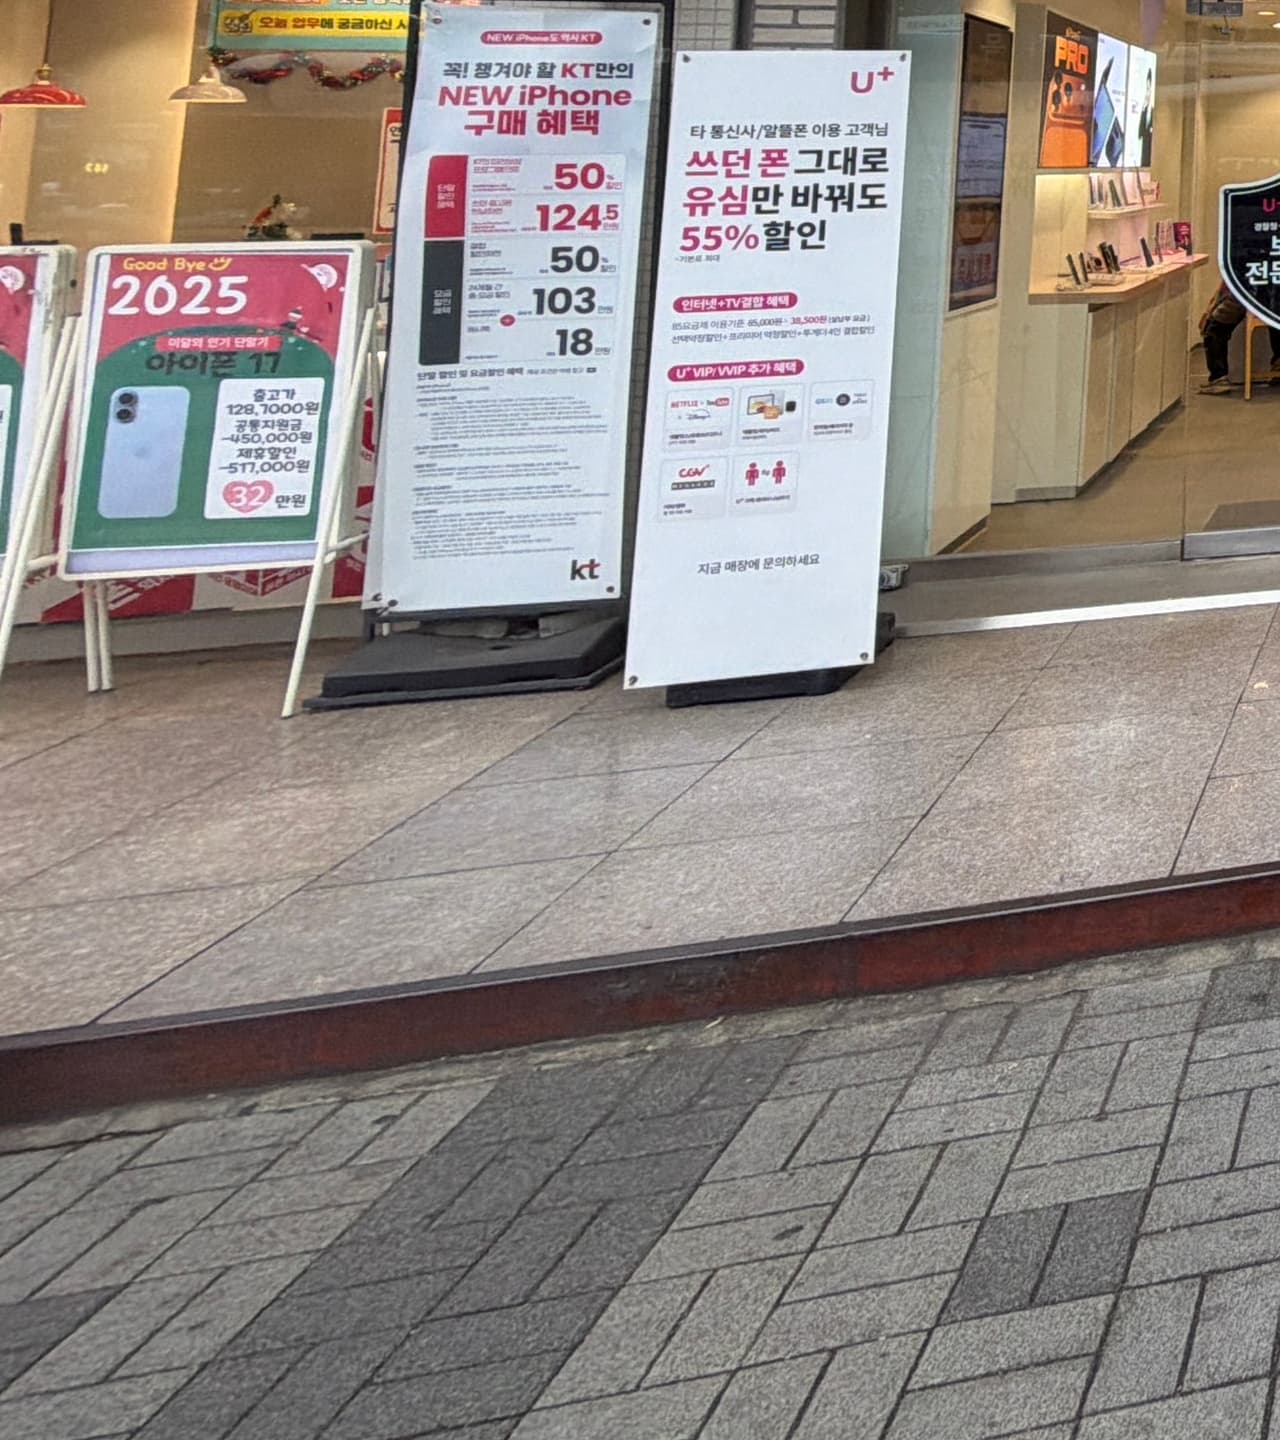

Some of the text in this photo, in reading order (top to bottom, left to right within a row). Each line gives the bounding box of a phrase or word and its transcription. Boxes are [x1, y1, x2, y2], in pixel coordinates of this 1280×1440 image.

[580, 33, 596, 43] KT
[442, 61, 634, 80] 꼭! 챙겨야 할 KT만의
[850, 66, 894, 94] U+
[438, 84, 633, 107] NEW iPhone
[464, 109, 600, 137] 구매 혜택
[690, 125, 706, 140] 타
[812, 122, 841, 138] 이용
[844, 122, 889, 138] 고객님
[554, 162, 606, 191] 50
[685, 146, 889, 179] 쓰던 폰 그대로
[682, 182, 888, 217] 유심만 바꿔도
[535, 203, 619, 232] 124.5
[679, 220, 827, 253] 55% 할인
[123, 257, 206, 273] Good Bye
[550, 245, 600, 274] 50
[107, 273, 249, 317] 2025
[532, 287, 596, 315] 103
[555, 328, 594, 356] 18
[145, 351, 282, 378] 아이폰 17
[252, 388, 296, 403] 출고가
[230, 486, 307, 509] 32 만원
[570, 559, 601, 581] kt
[697, 553, 821, 576] 지금 매장에 문의하세요
